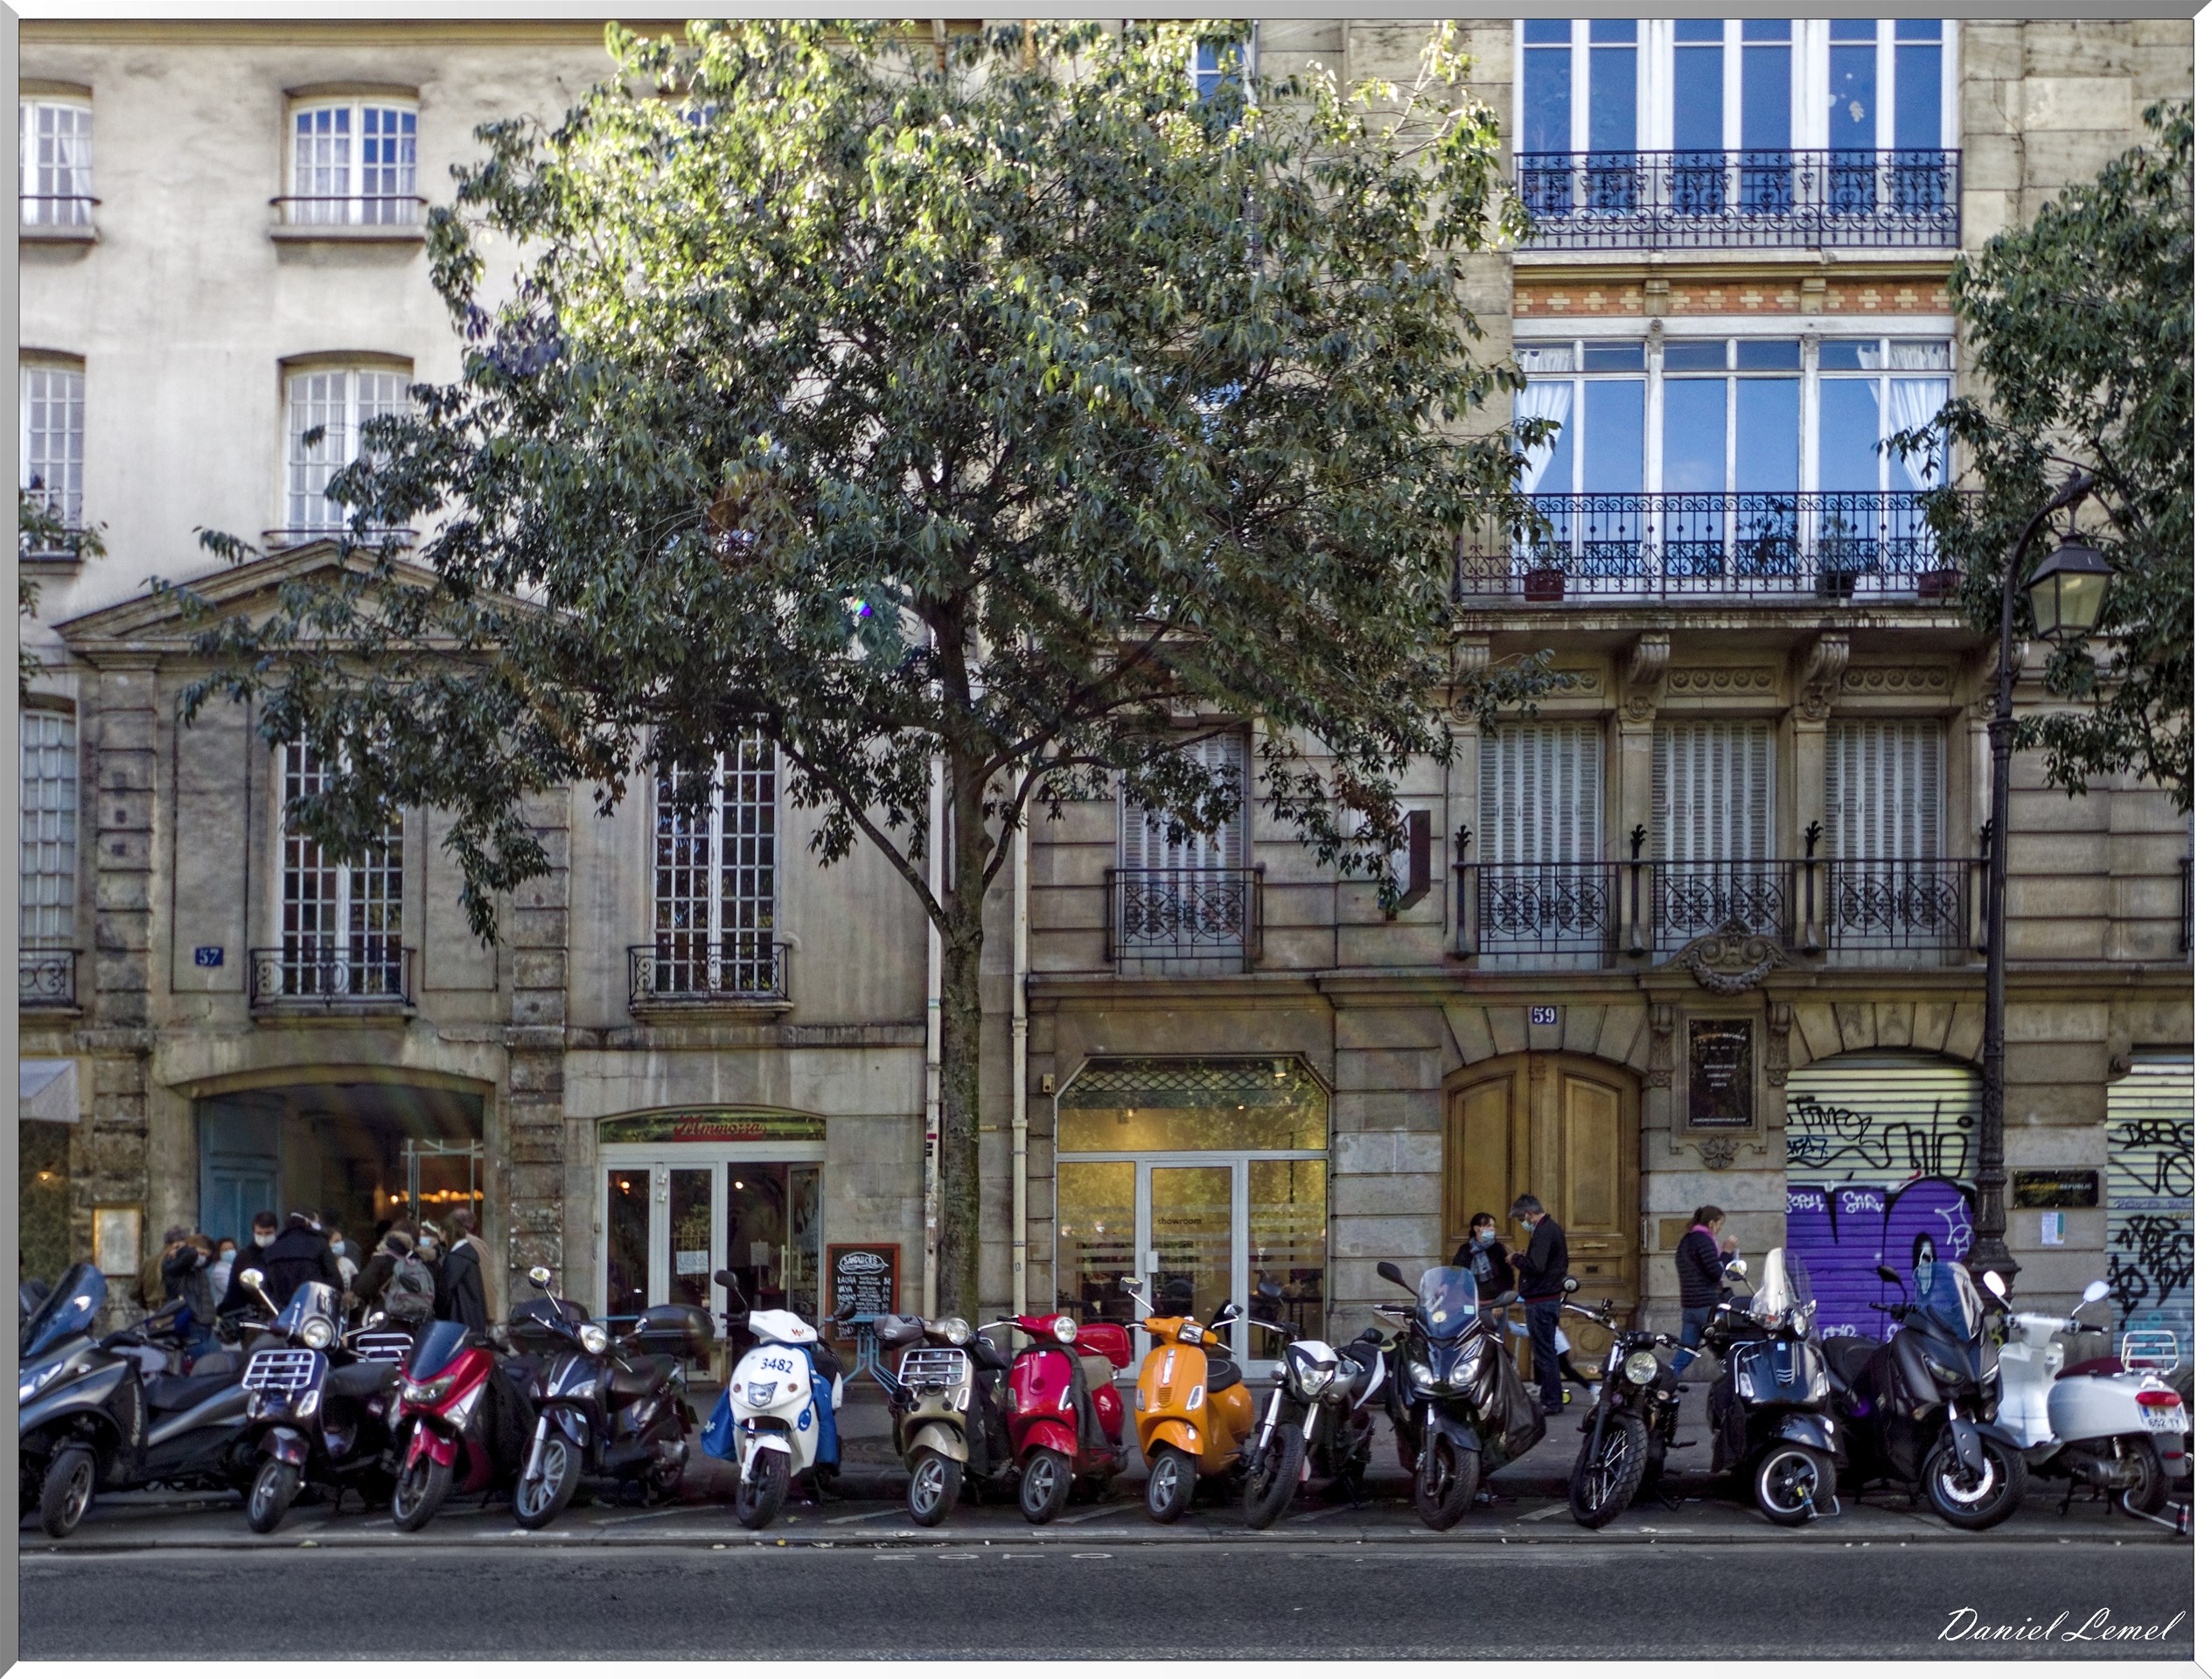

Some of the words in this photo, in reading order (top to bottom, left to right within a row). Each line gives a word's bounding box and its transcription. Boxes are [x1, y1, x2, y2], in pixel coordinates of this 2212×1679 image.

[199, 948, 219, 964] 57
[1534, 1007, 1555, 1023] 59
[1157, 1216, 1202, 1225] showroom
[760, 1358, 793, 1374] 3482
